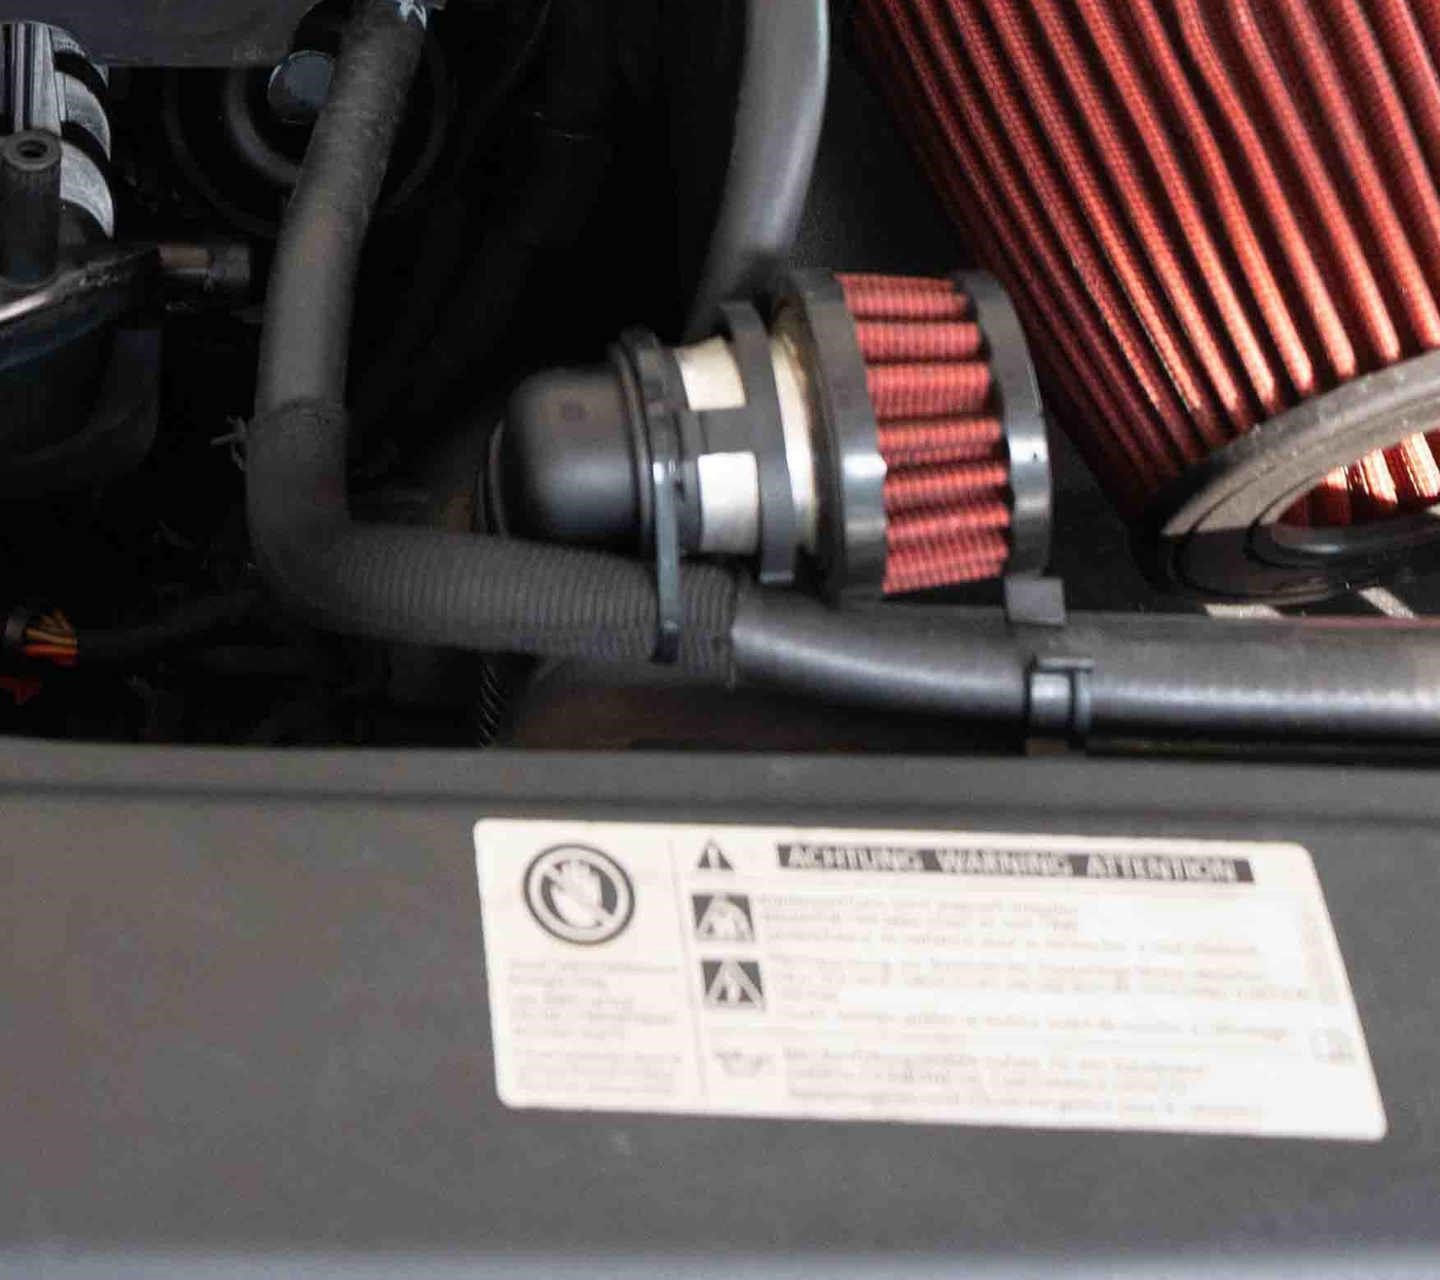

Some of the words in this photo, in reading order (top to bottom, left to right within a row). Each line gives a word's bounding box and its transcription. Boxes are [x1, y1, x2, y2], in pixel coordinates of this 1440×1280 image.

[787, 844, 920, 871] ACHTUNG
[936, 847, 1074, 876] WARNING
[1086, 852, 1236, 882] ATTENTION
